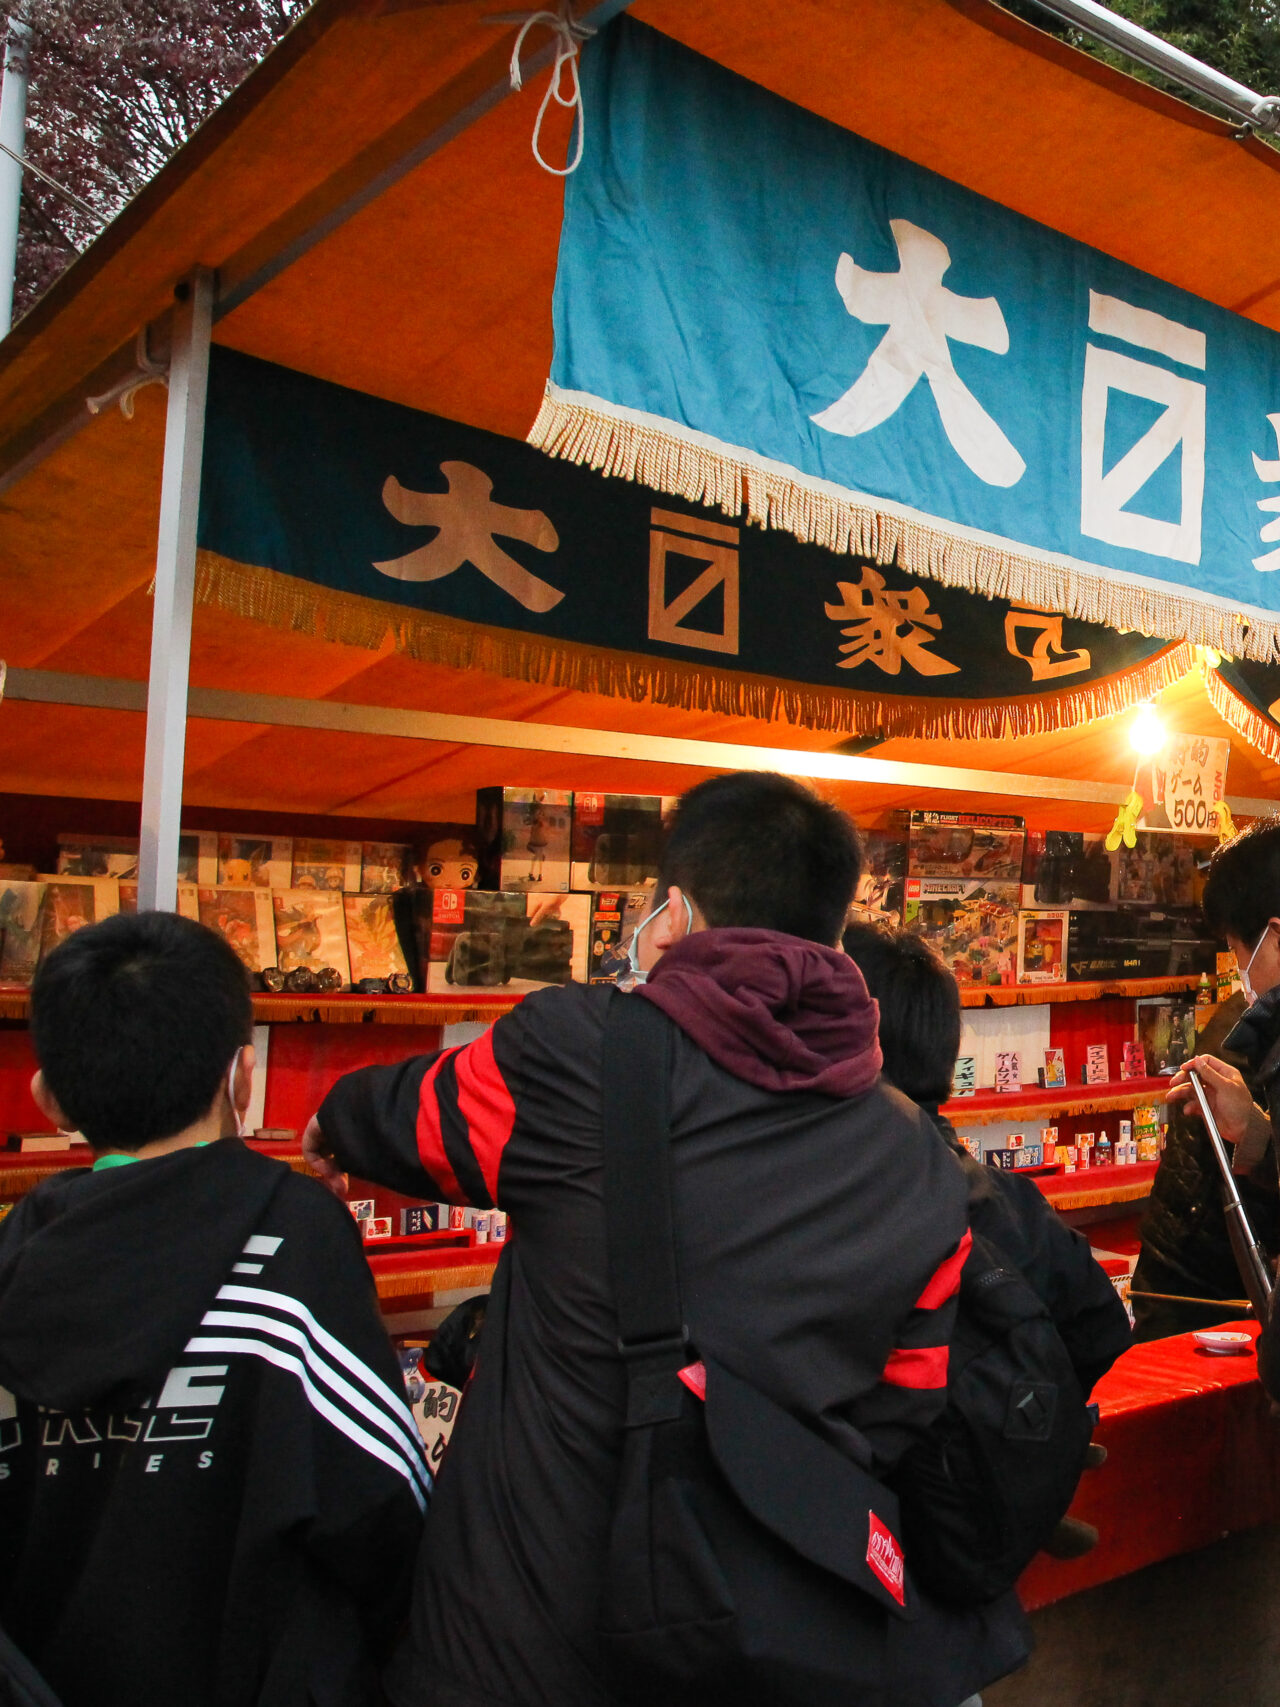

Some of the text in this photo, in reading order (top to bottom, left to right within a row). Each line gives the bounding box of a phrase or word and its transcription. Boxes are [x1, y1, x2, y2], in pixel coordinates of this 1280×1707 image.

[1171, 769, 1203, 796] ゲーム
[1173, 799, 1219, 830] 500円
[997, 1053, 1010, 1093] ゲームソフト
[0, 1451, 213, 1480] SRIES
